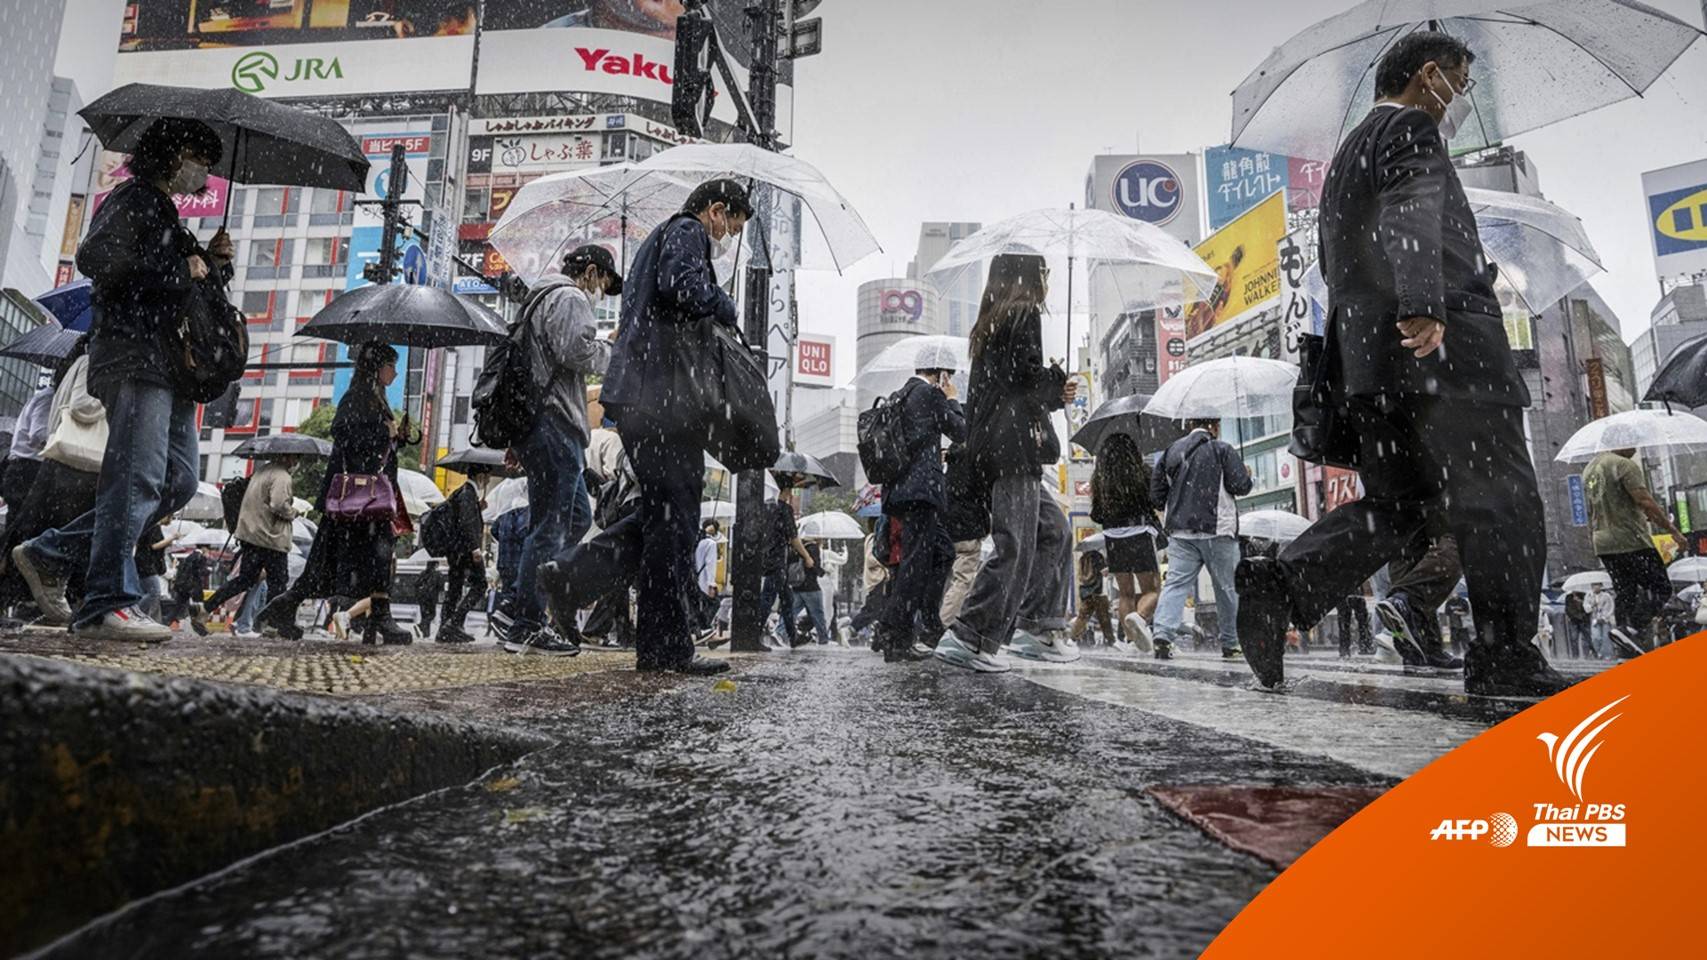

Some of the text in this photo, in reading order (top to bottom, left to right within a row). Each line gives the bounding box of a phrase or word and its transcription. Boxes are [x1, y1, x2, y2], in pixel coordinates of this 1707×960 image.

[285, 56, 343, 81] JRA
[574, 47, 675, 85] Yaku
[471, 148, 492, 162] 9F
[1222, 152, 1271, 181] 龍角散
[1243, 266, 1280, 296] JOHNNI
[1243, 280, 1280, 306] WALKE
[880, 288, 923, 321] 109
[801, 343, 826, 359] UNI
[801, 357, 828, 372] QLO
